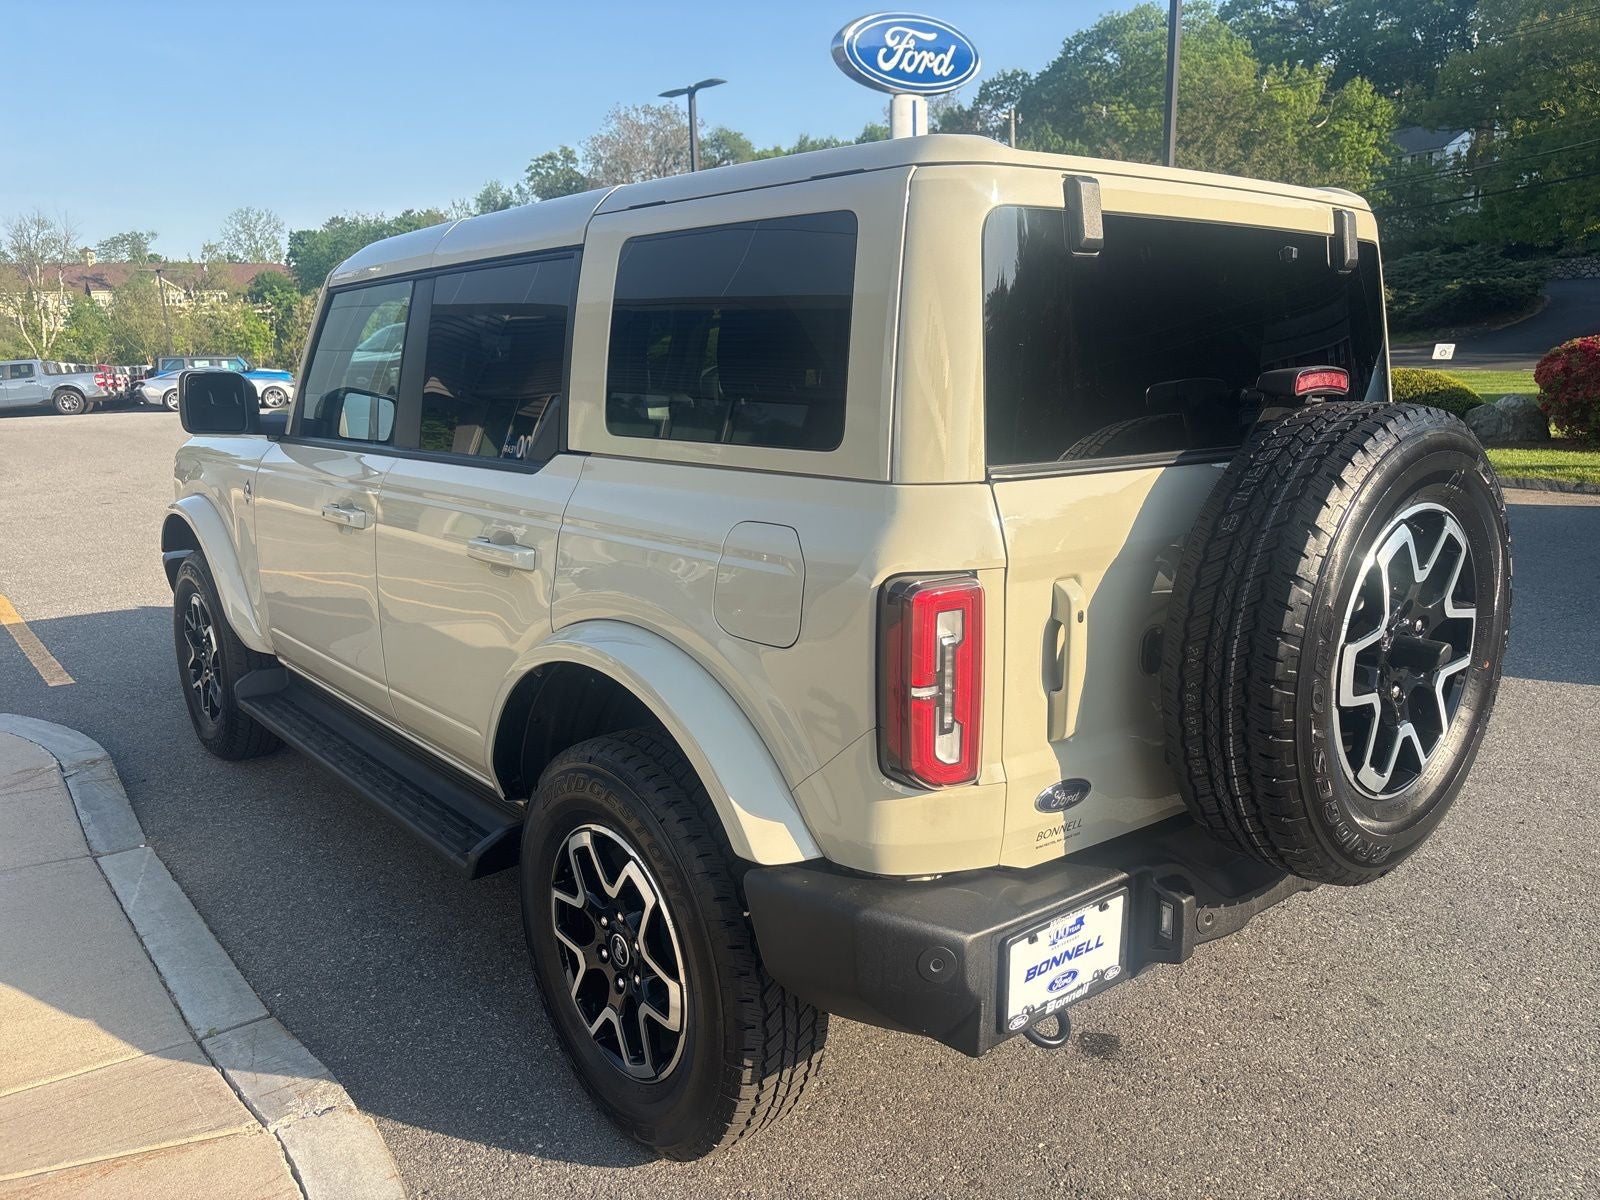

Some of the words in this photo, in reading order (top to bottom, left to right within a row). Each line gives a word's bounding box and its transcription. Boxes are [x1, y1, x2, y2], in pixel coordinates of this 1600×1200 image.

[877, 26, 957, 77] Ford
[1036, 819, 1082, 842] BONNELL
[1024, 935, 1104, 983] BONNELL
[1051, 970, 1074, 991] Ford
[1045, 983, 1090, 1014] Bonnell
